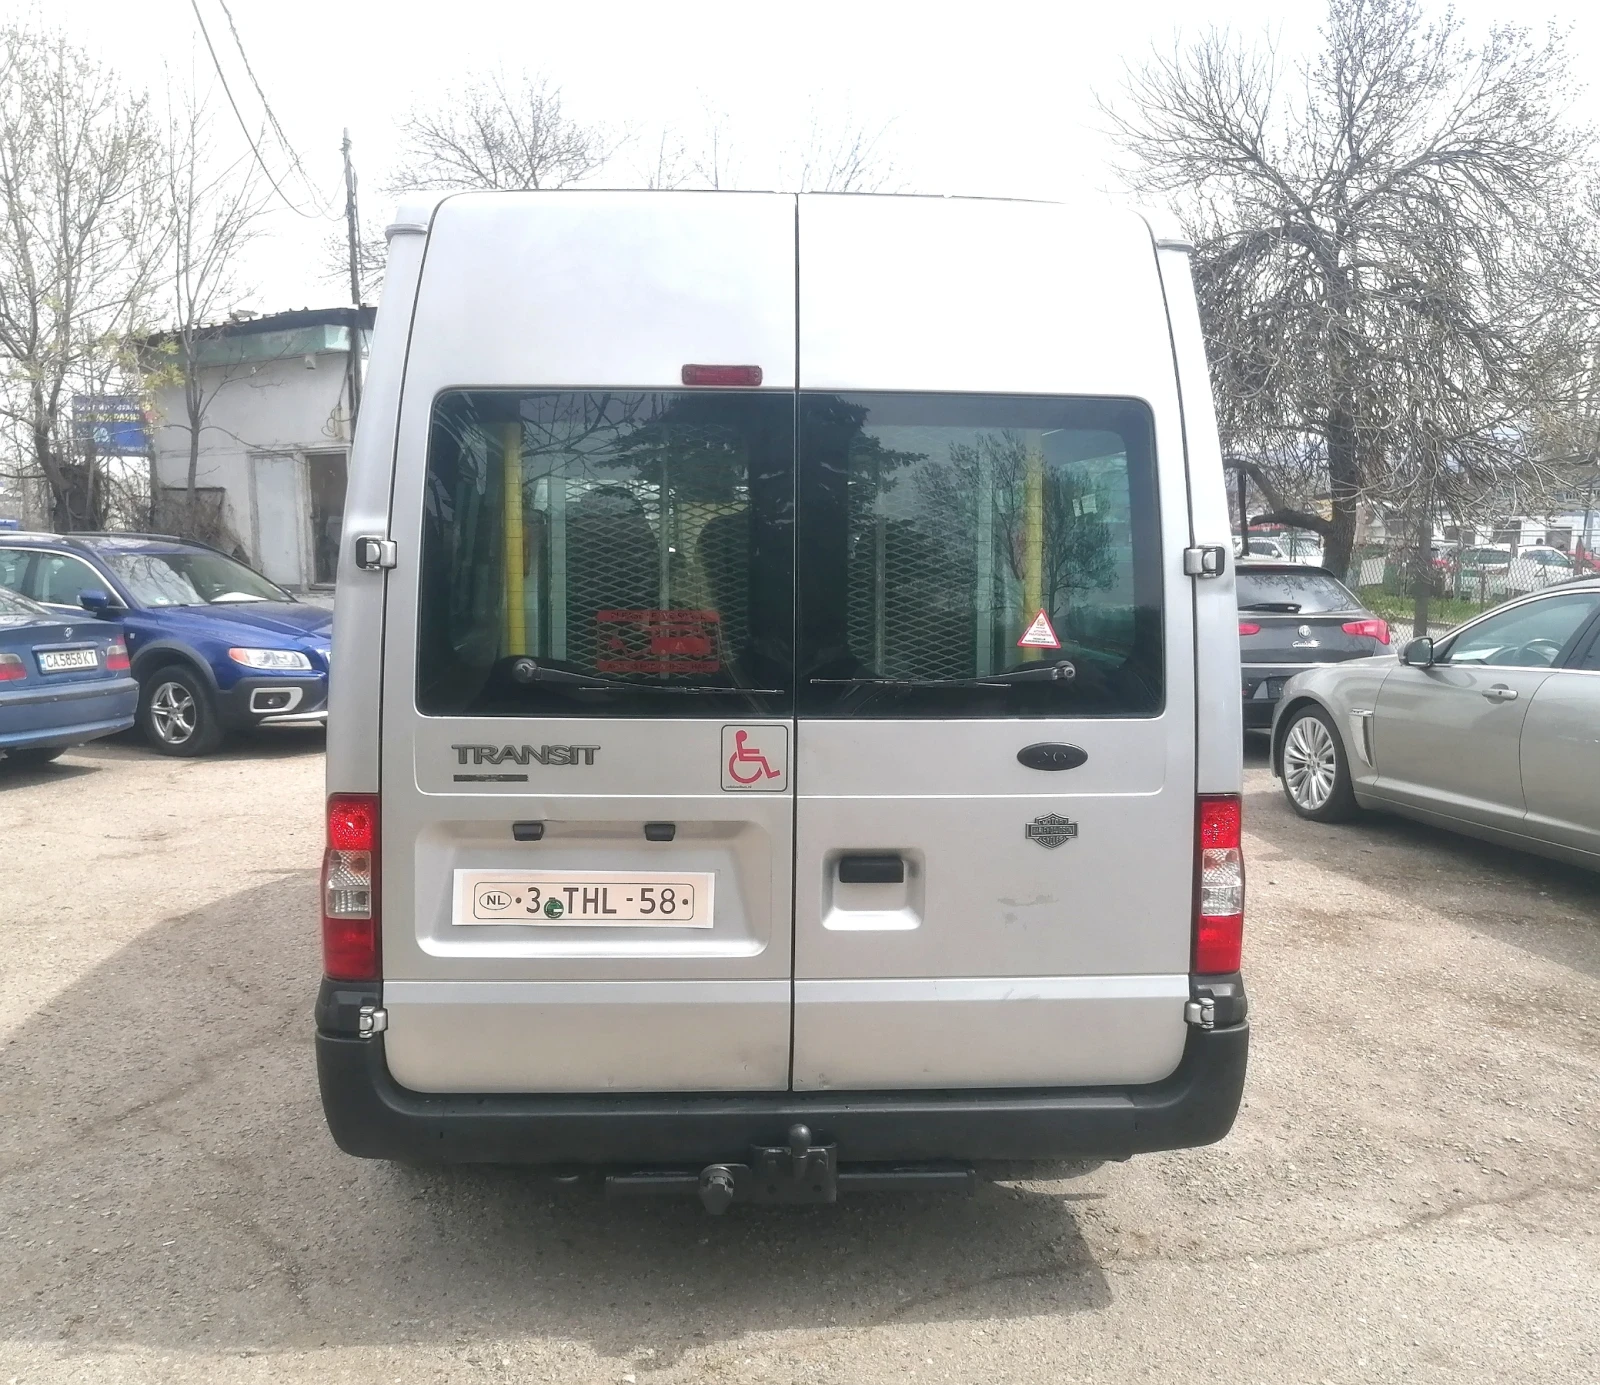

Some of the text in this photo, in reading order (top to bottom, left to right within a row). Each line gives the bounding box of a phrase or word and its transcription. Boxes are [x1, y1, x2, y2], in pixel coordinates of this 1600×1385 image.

[46, 652, 94, 667] CA5858KT
[452, 744, 601, 766] TRANSIT
[487, 895, 505, 905] NL
